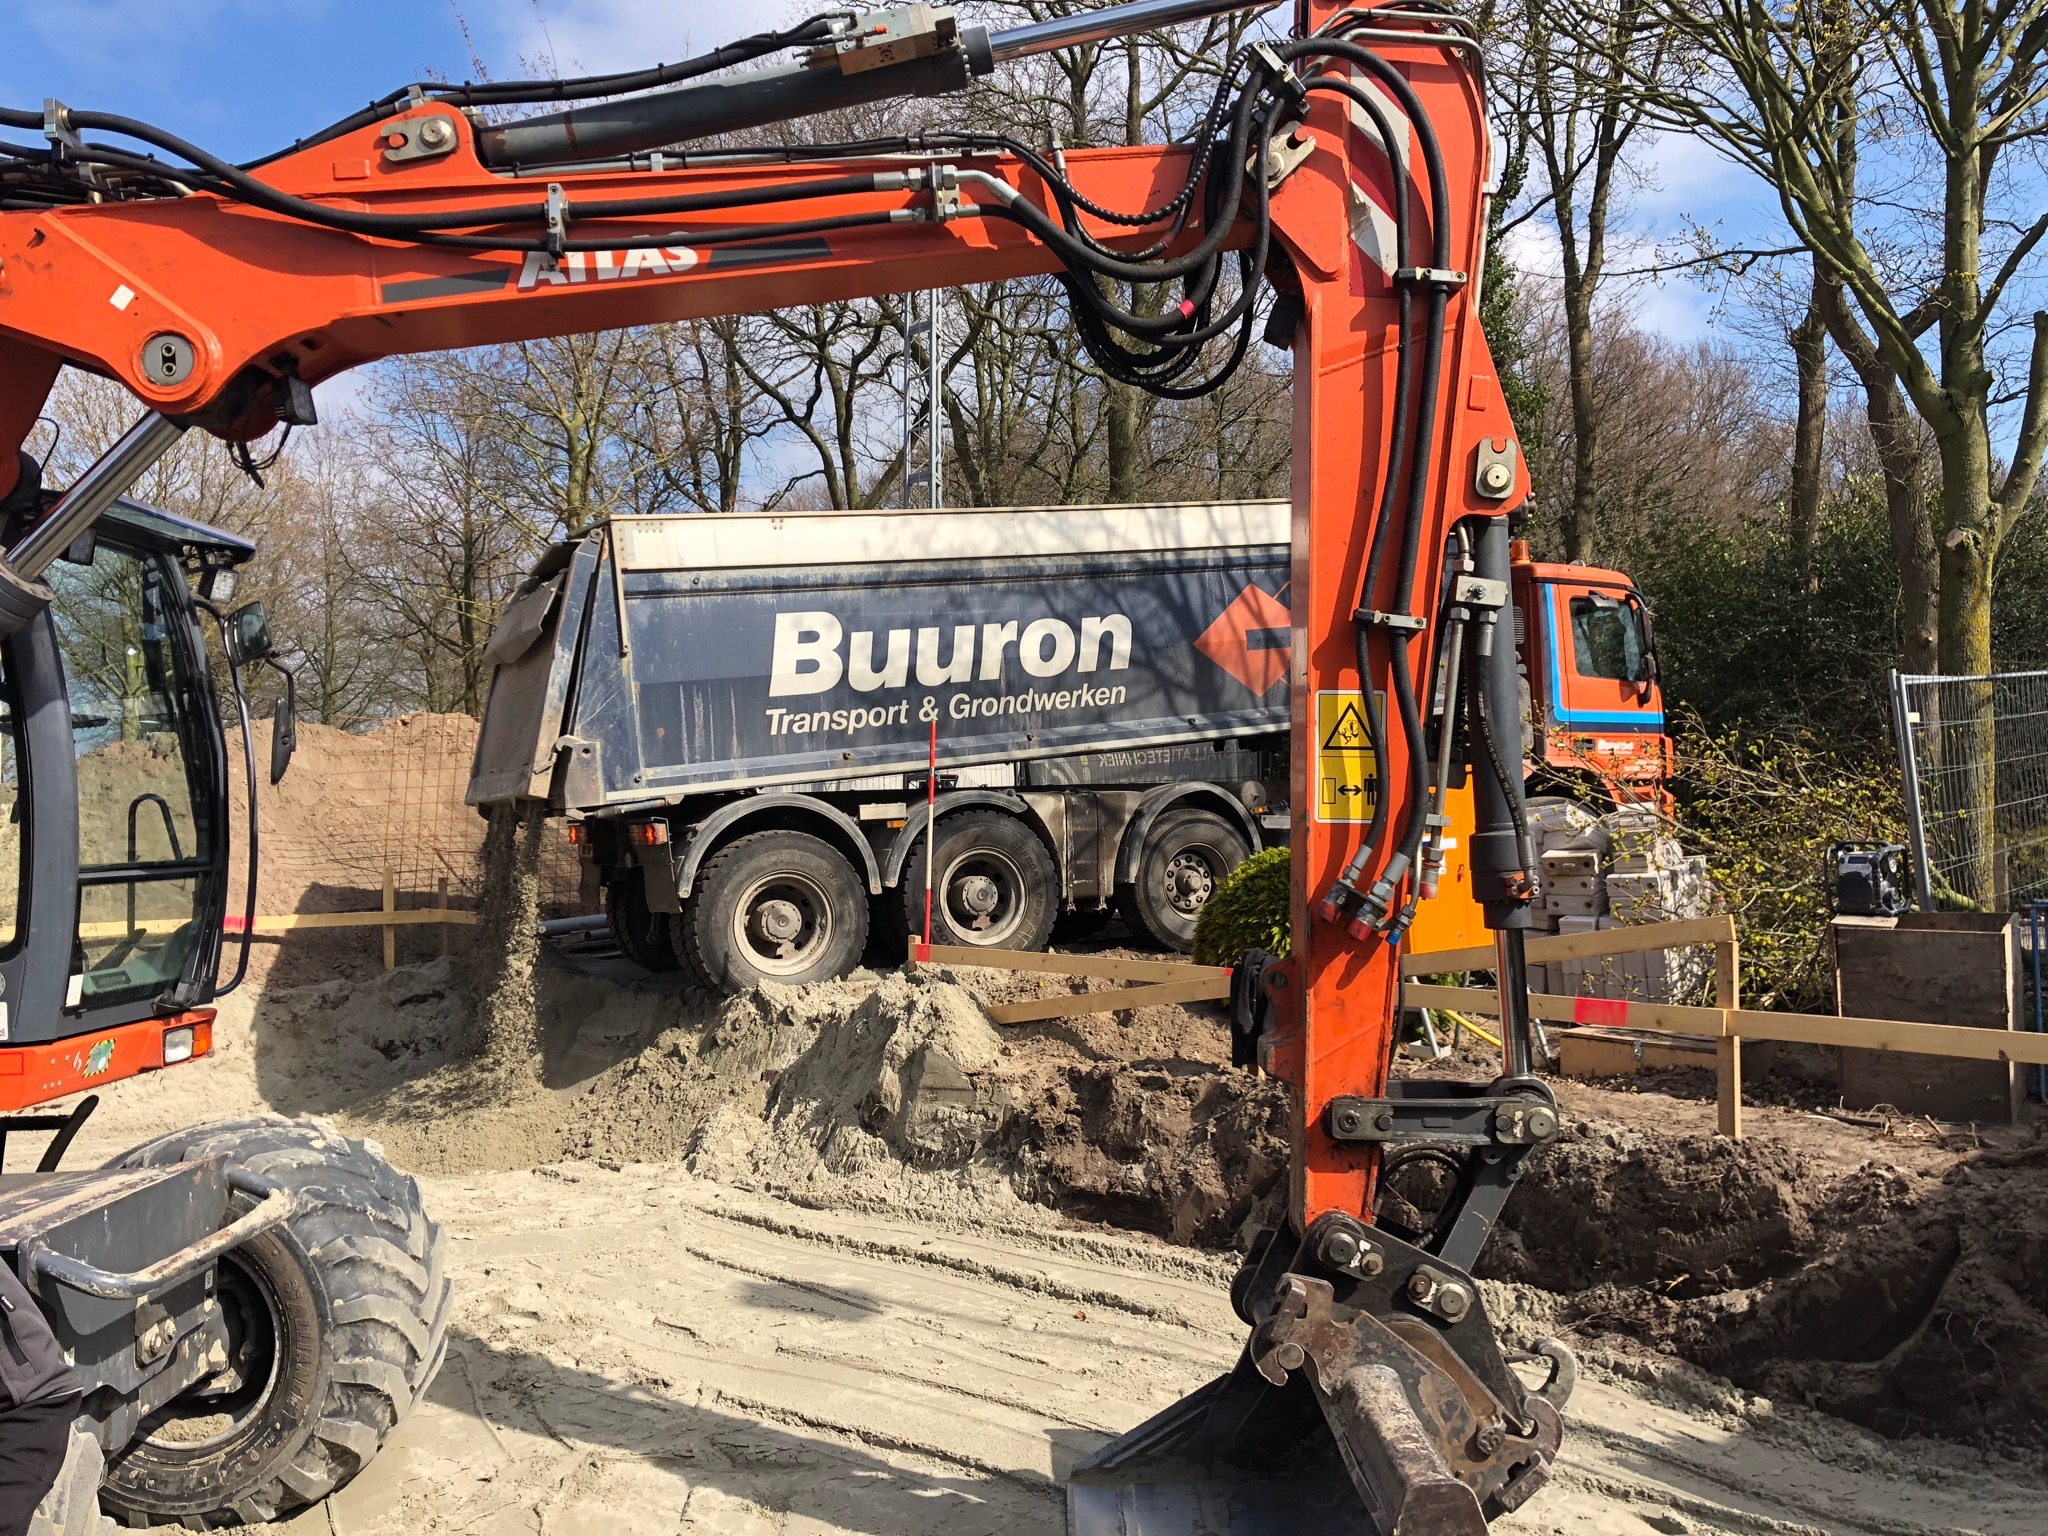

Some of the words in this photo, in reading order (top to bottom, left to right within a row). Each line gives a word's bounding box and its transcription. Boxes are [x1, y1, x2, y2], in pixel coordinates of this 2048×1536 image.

[518, 232, 698, 288] ATLAS
[768, 611, 1133, 698] Buuron
[765, 699, 910, 736] Transport
[918, 696, 939, 722] &
[948, 682, 1127, 720] Grondwerken
